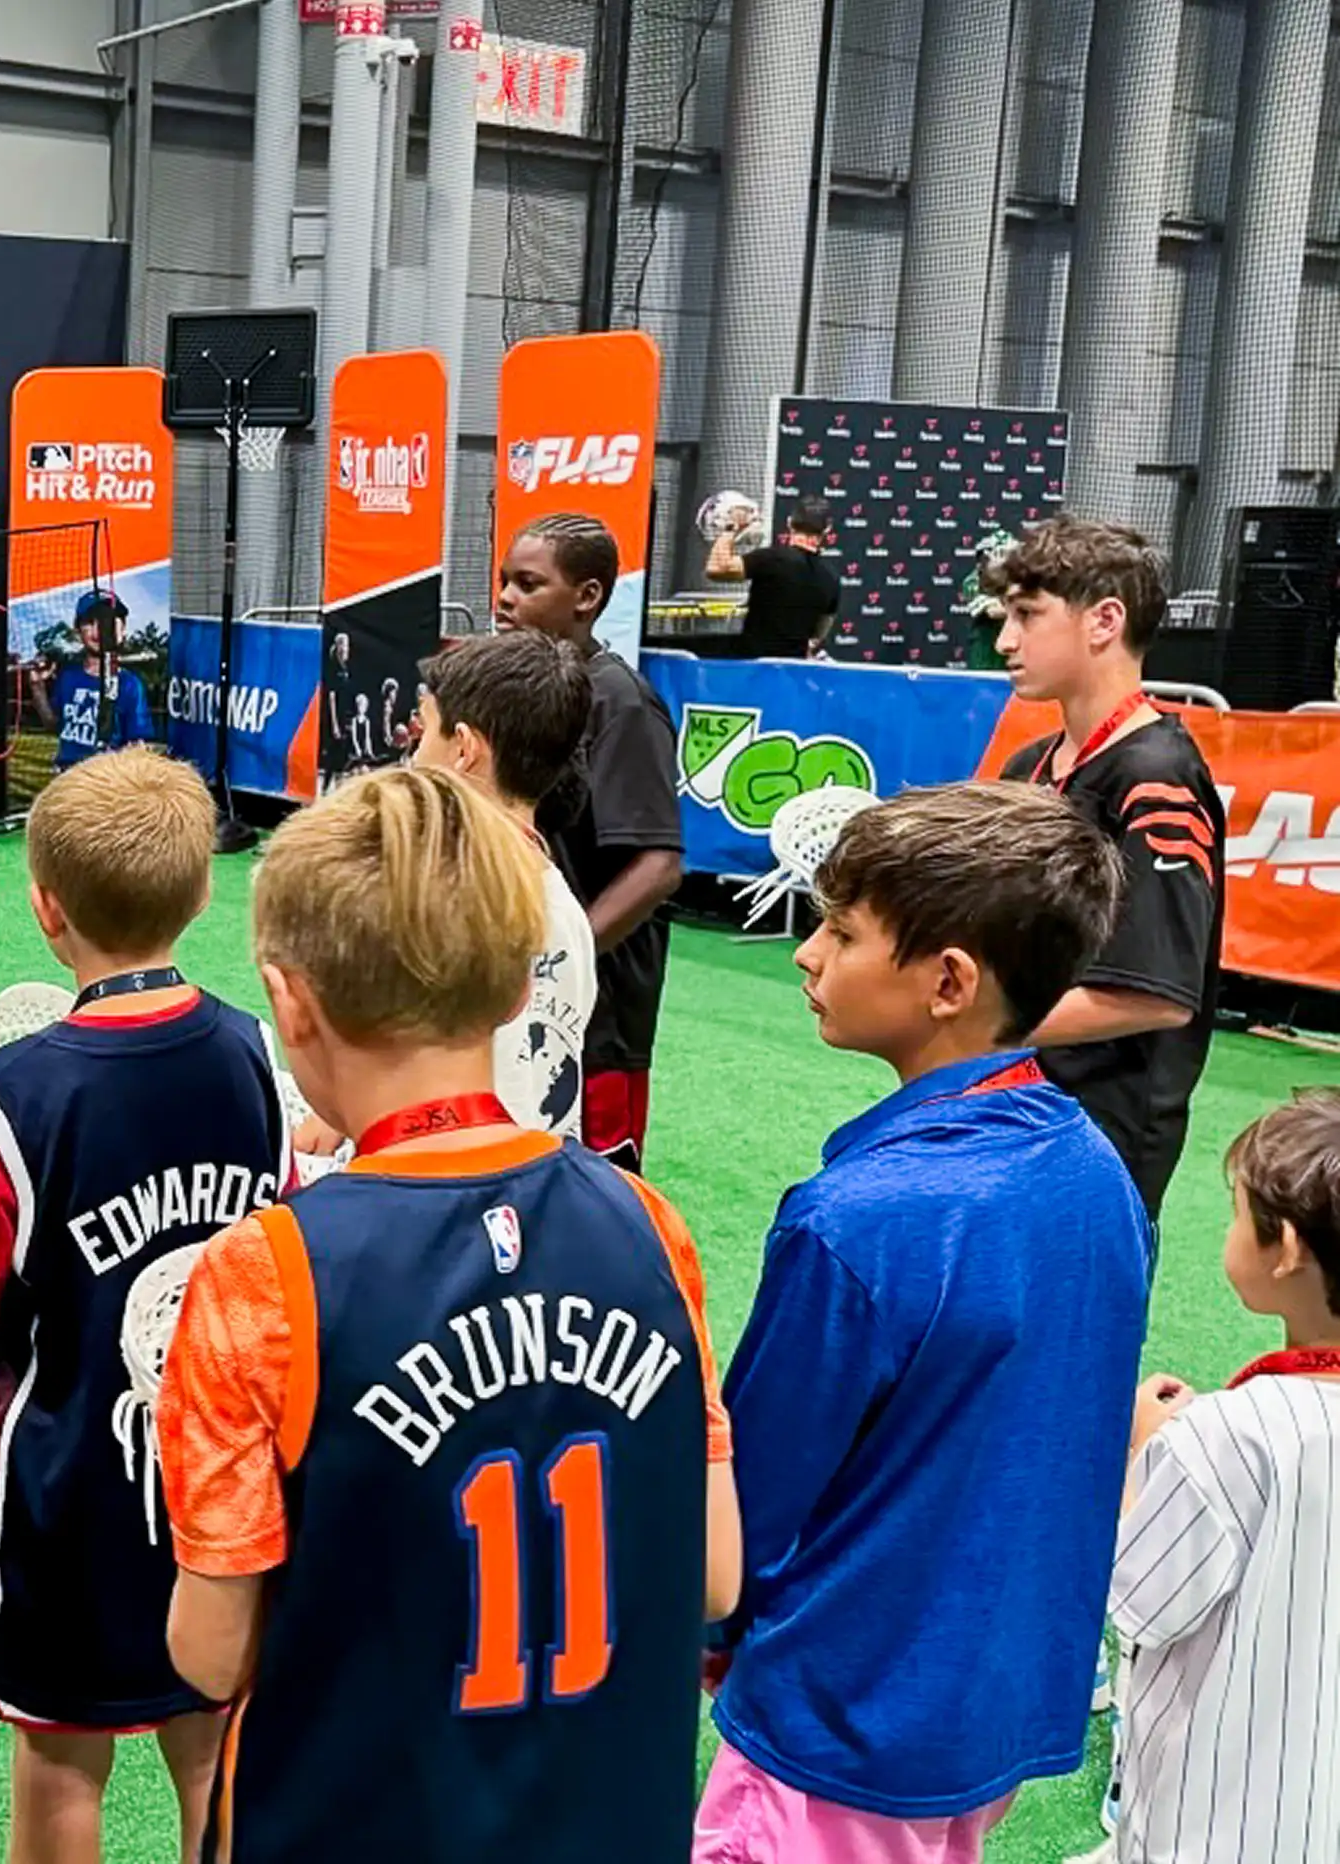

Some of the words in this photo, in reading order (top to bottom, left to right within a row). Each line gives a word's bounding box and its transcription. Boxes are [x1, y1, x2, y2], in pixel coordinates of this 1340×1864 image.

[476, 50, 579, 119] XIT
[26, 473, 67, 501] Hit
[71, 474, 91, 500] &
[94, 473, 155, 501] Run
[77, 443, 153, 471] Pitch
[524, 435, 640, 492] FLAG
[690, 716, 730, 738] MLS
[67, 1162, 276, 1277] EDWARDS
[352, 1293, 682, 1468] BRUNSON
[451, 1430, 617, 1715] 11
